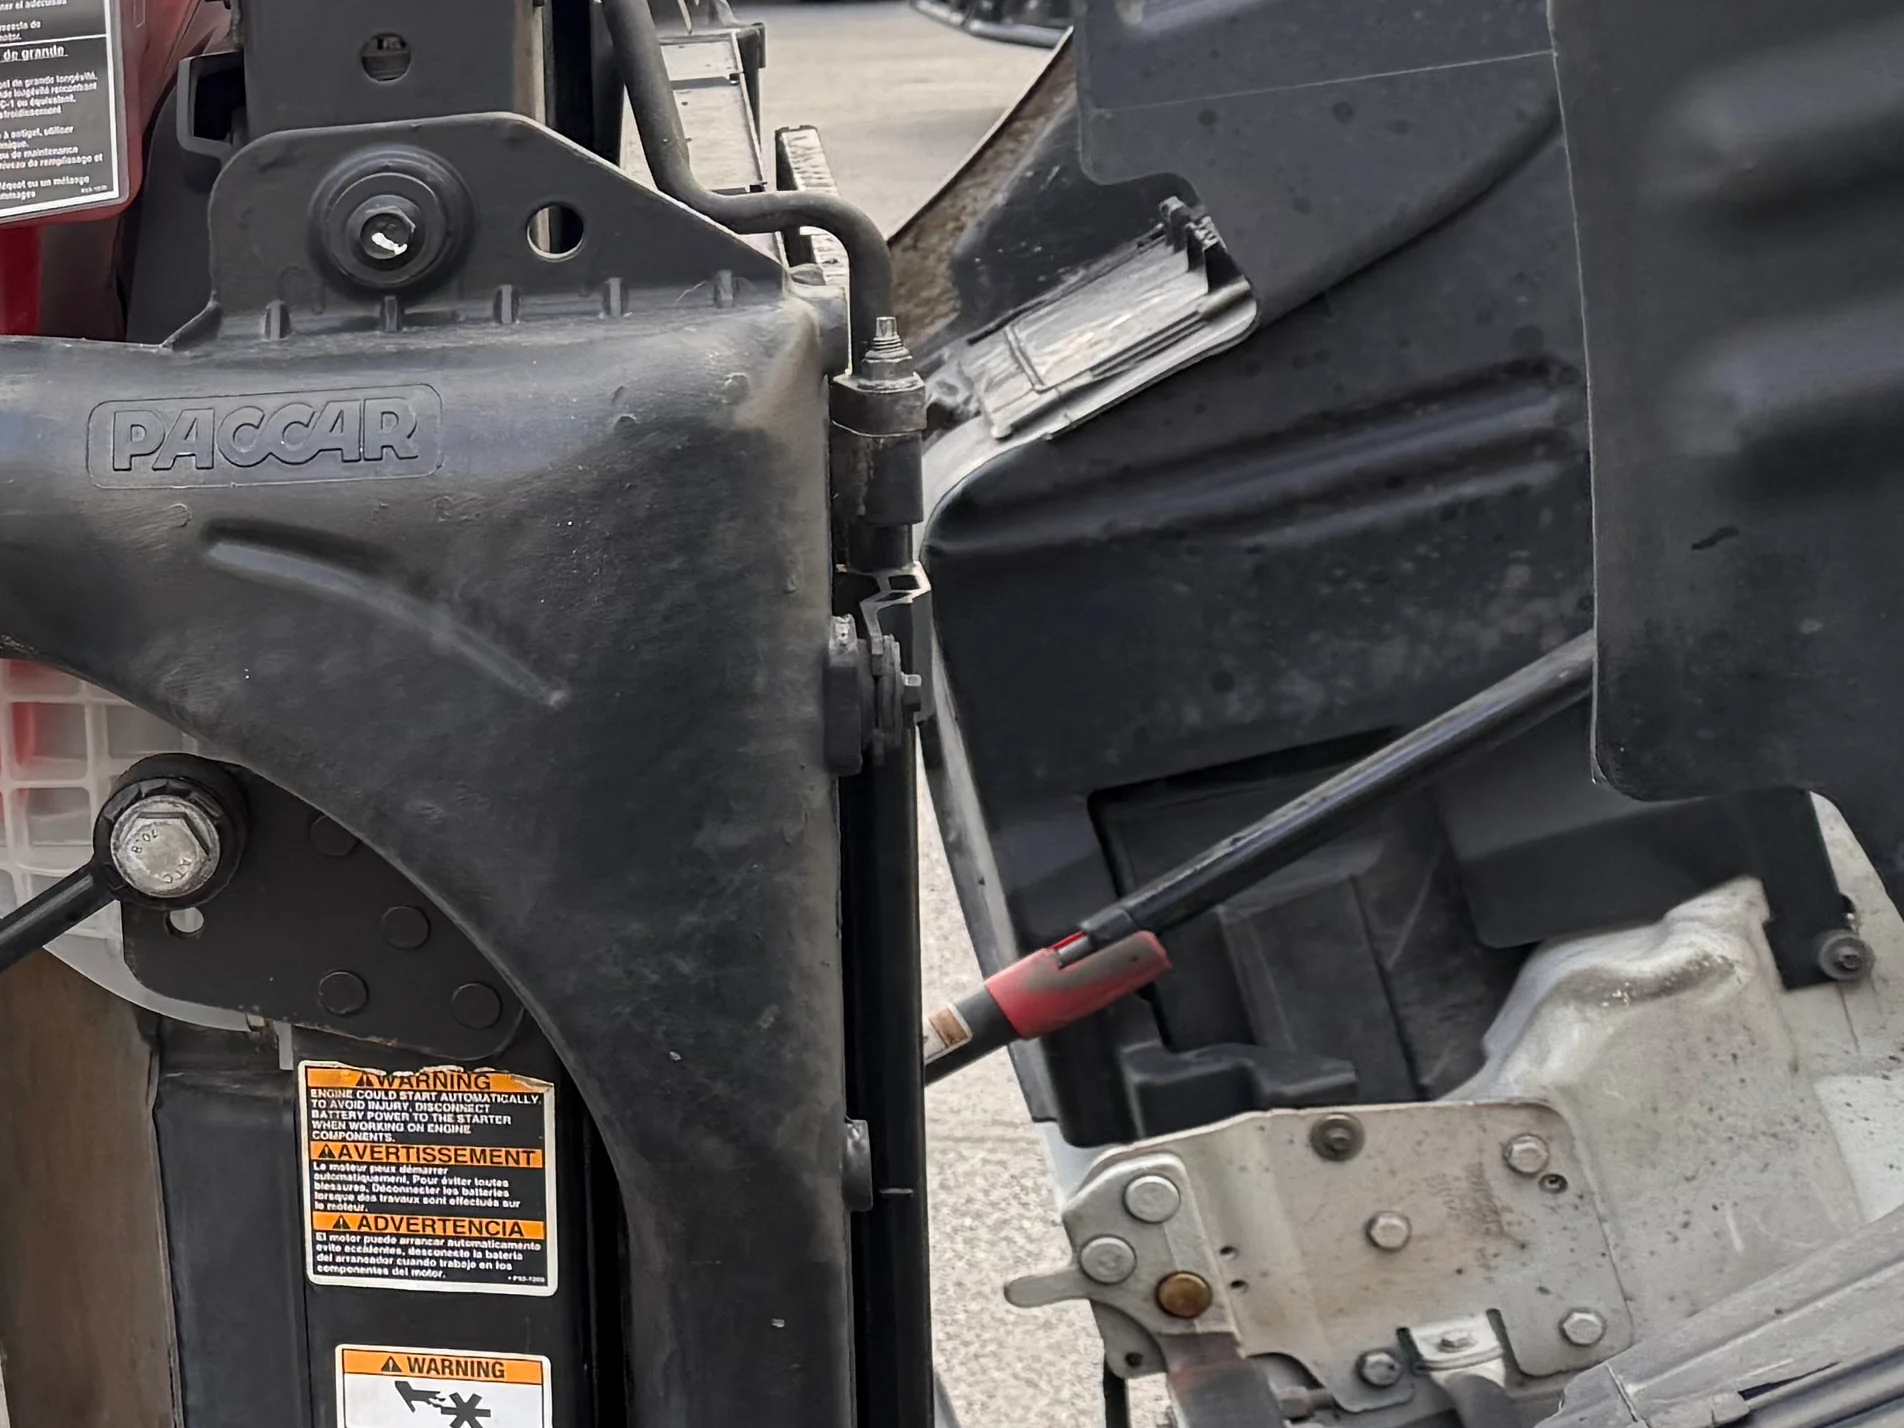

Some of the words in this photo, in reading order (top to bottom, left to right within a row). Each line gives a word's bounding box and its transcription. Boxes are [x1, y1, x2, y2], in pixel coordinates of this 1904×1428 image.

[112, 398, 420, 471] PACCAR
[377, 1073, 491, 1090] WARNING
[311, 1089, 353, 1099] ENGINE
[356, 1090, 396, 1100] COULD
[400, 1091, 437, 1101] START
[312, 1100, 327, 1109] TO
[330, 1100, 364, 1110] AVOID
[416, 1103, 490, 1114] DISCONNECT
[312, 1110, 364, 1121] BATTERY
[367, 1112, 409, 1122] POWER
[413, 1113, 429, 1122] TO
[432, 1114, 454, 1123] THE
[457, 1115, 511, 1125] STARTER
[312, 1121, 346, 1130] WHEN
[349, 1121, 405, 1132] WORKING
[408, 1123, 424, 1133] ON
[428, 1124, 471, 1134] ENGINE
[312, 1131, 396, 1143] COMPONENTS.
[338, 1143, 536, 1166] AVERTISSEMENT
[313, 1162, 326, 1171] Le
[329, 1163, 367, 1172] moteur
[370, 1164, 396, 1175] peux
[400, 1164, 448, 1175] démarrer
[413, 1175, 438, 1185] Pour
[441, 1175, 472, 1186] éviter
[475, 1177, 509, 1188] toutes
[372, 1184, 440, 1195] Déconnecter
[443, 1186, 459, 1195] les
[462, 1186, 509, 1197] batteries
[314, 1191, 355, 1203] lorsque
[358, 1193, 377, 1202] des
[380, 1194, 419, 1204] travaux
[423, 1195, 446, 1206] sont
[450, 1196, 499, 1207] effectués
[503, 1199, 520, 1208] sur
[315, 1201, 325, 1211] le
[327, 1202, 368, 1212] moteur.
[357, 1216, 524, 1237] ADVERTENCIA
[316, 1232, 326, 1242] El
[329, 1233, 361, 1243] motor
[364, 1235, 396, 1247] puede
[400, 1236, 444, 1246] arrancar
[448, 1238, 541, 1250] automaticamente
[407, 1356, 505, 1378] WARNING
